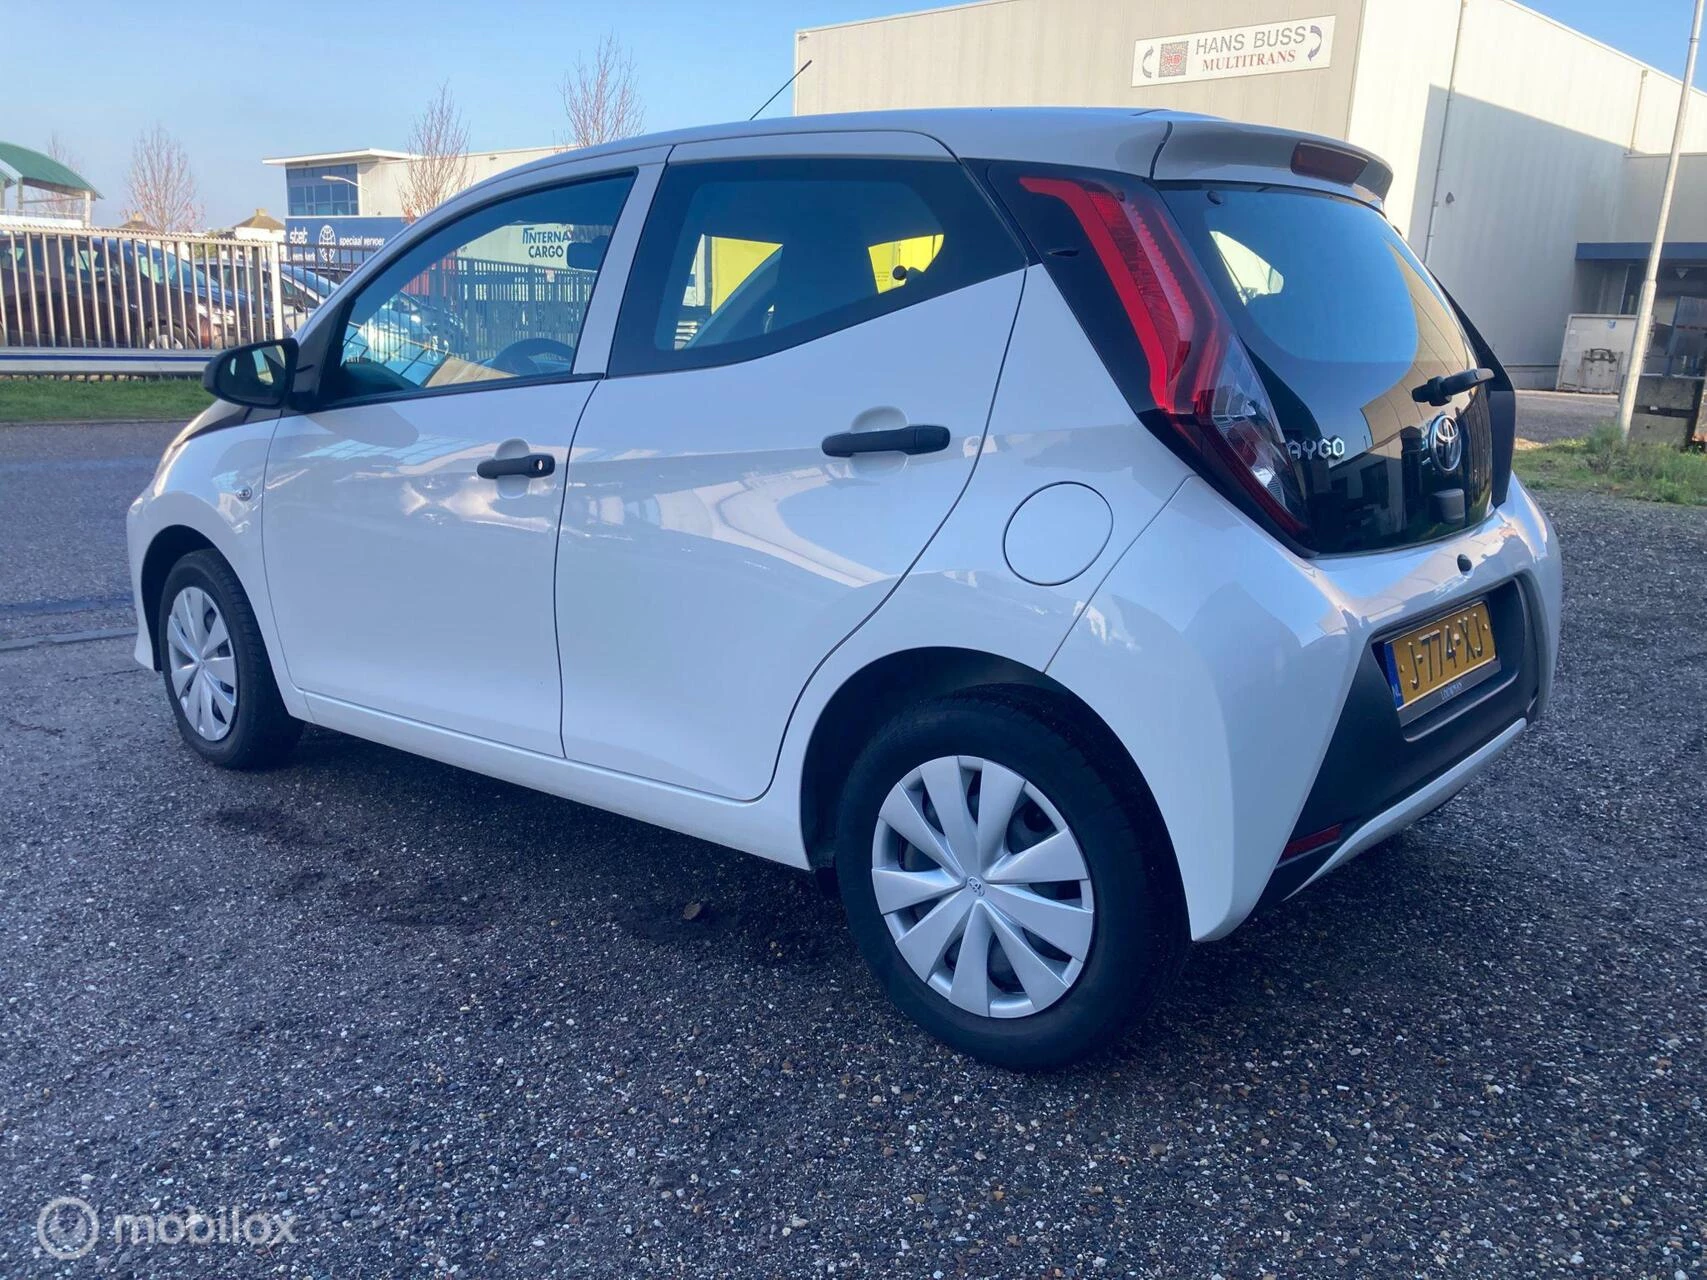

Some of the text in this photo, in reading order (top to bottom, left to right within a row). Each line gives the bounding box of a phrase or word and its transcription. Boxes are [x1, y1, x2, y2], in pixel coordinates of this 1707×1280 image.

[1195, 25, 1306, 55] HANS BUSS
[1203, 49, 1297, 72] MULTITRANS
[528, 245, 564, 258] CARGO
[1287, 436, 1346, 461] AYGO
[1407, 612, 1485, 690] J-774-XJ
